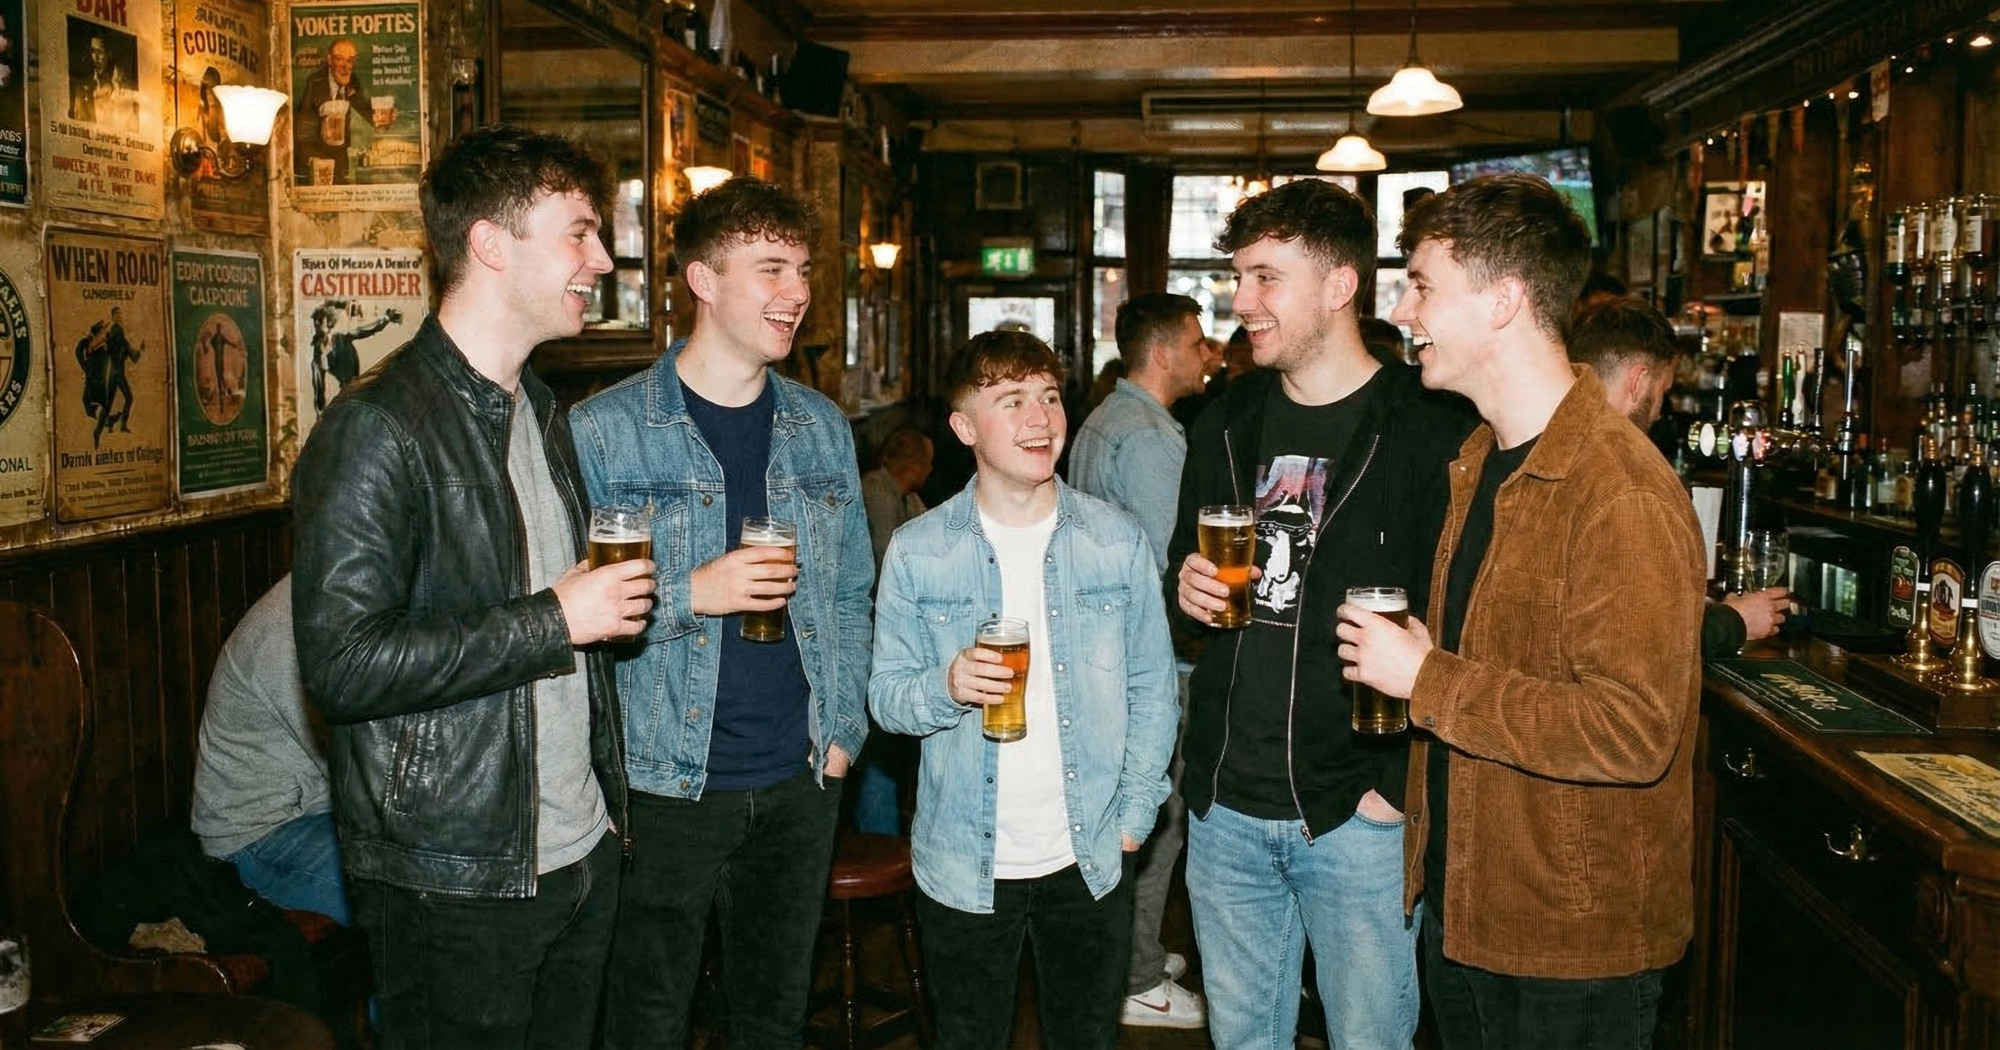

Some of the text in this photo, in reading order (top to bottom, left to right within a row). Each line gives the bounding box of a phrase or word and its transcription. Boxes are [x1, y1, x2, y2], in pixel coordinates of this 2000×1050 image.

[352, 13, 416, 34] POFTES
[51, 244, 160, 286] WHEN ROAD
[375, 258, 383, 269] A
